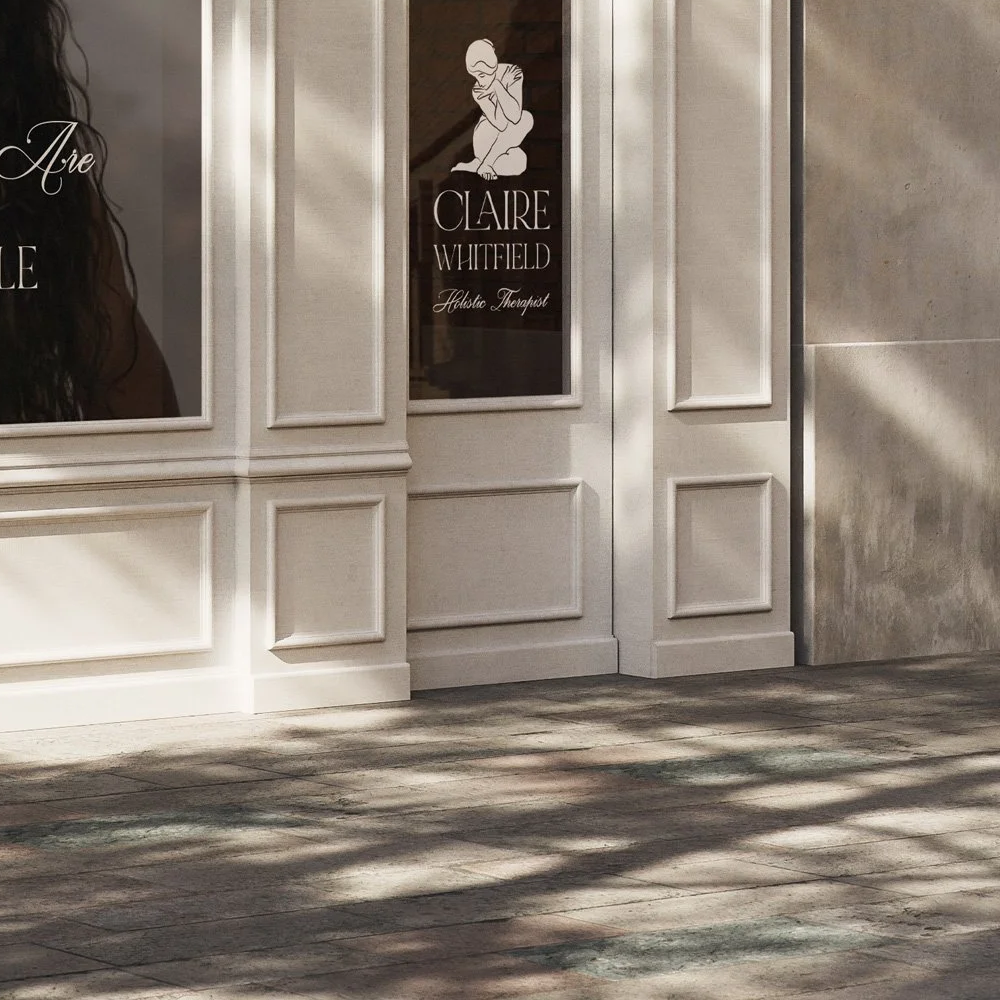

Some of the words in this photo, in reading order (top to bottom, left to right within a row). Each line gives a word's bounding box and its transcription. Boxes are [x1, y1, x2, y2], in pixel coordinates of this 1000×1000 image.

[433, 189, 551, 232] CLAIRE
[433, 243, 551, 272] WHITFIELD
[432, 288, 486, 314] Holistic
[490, 287, 550, 316] Therapist
